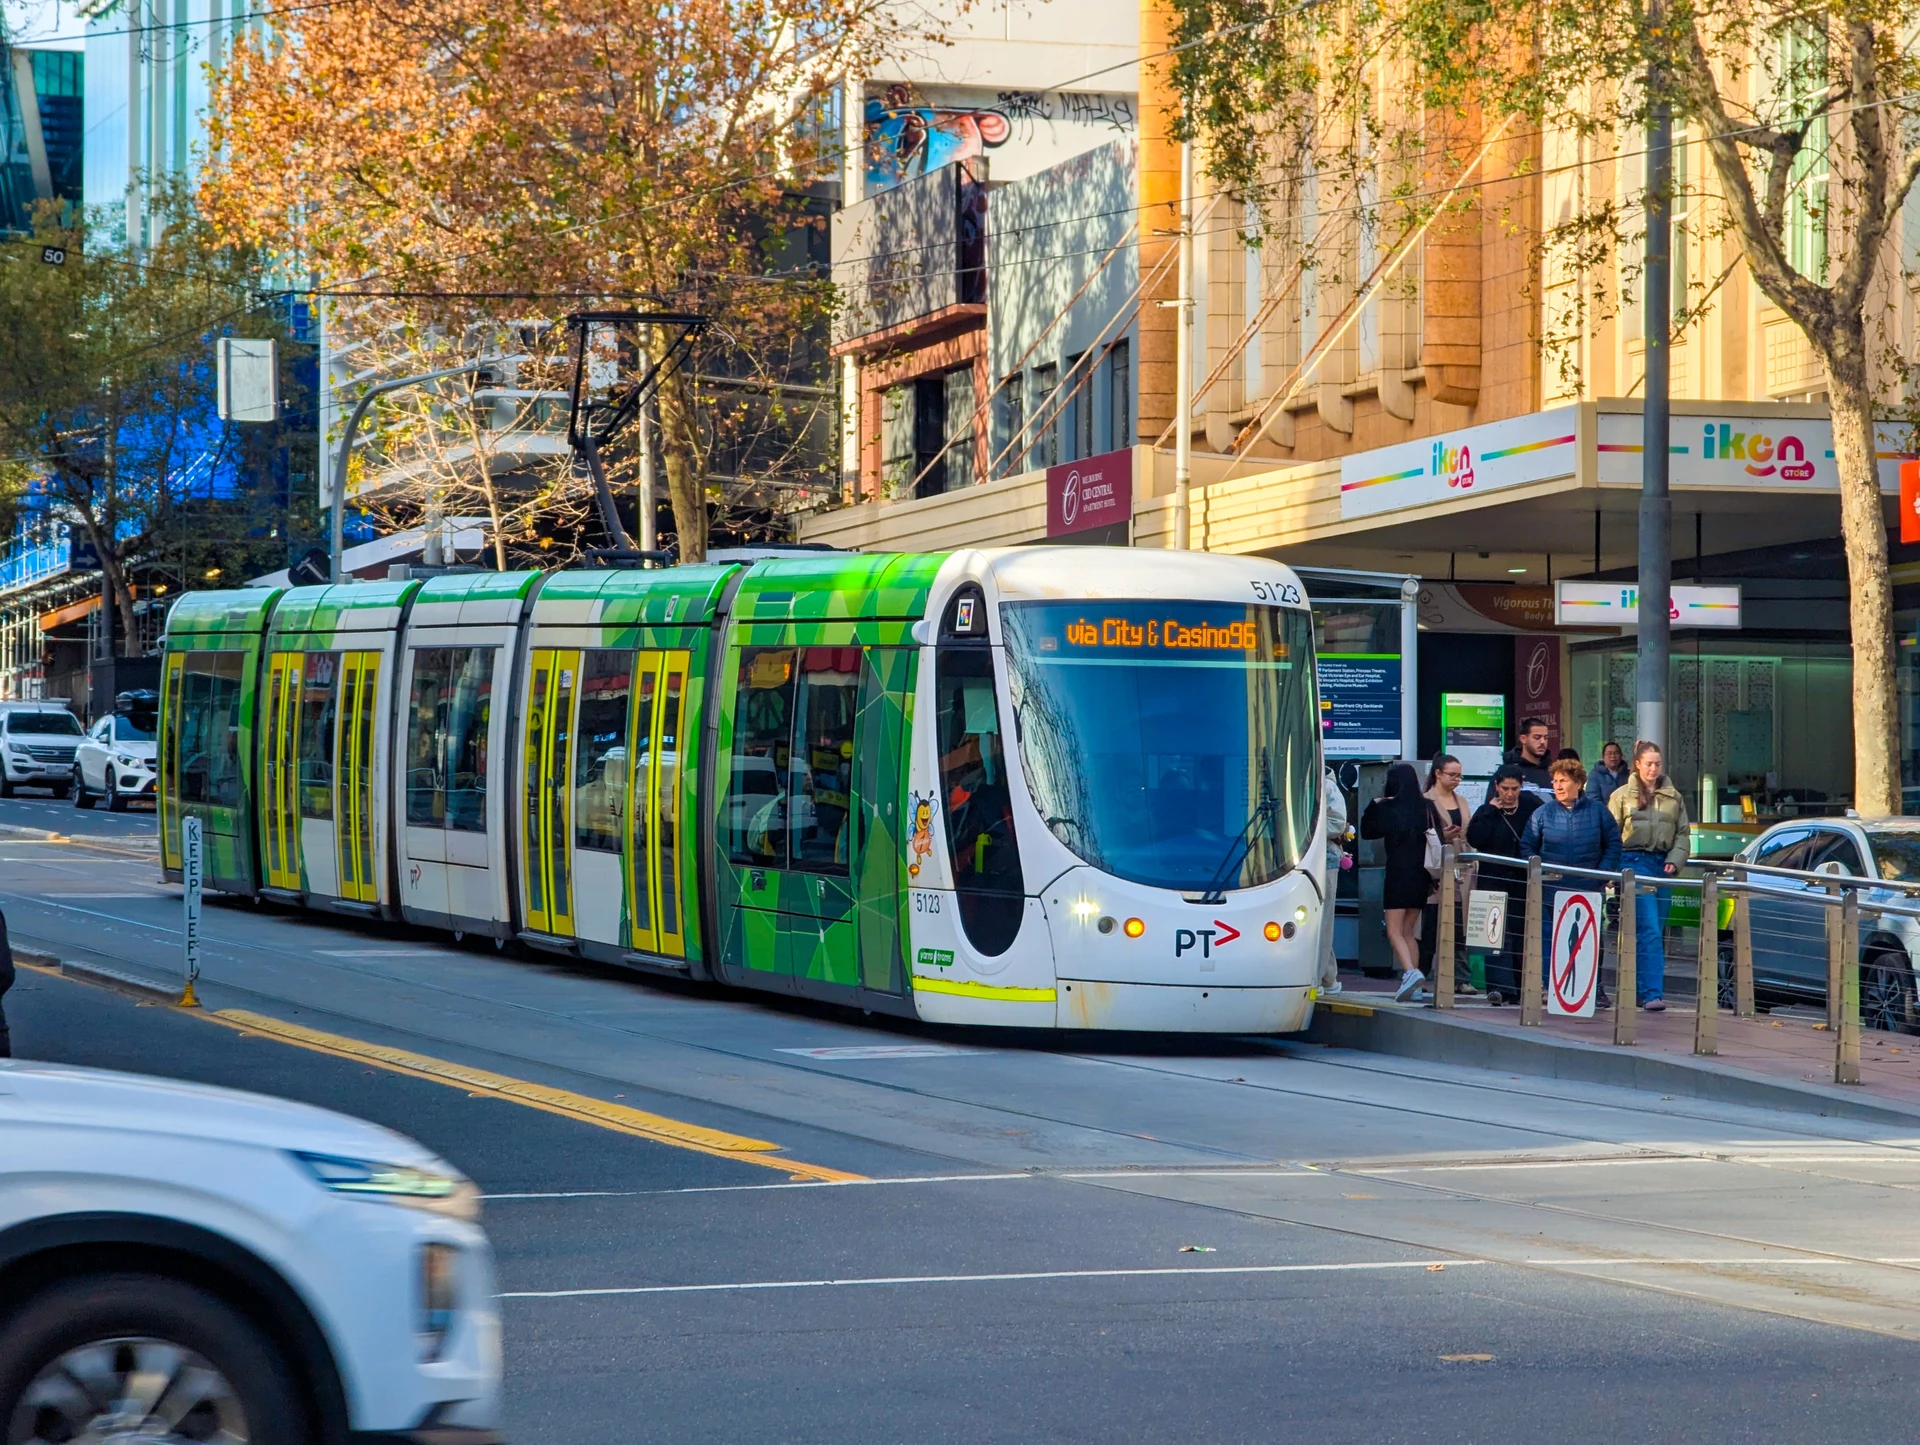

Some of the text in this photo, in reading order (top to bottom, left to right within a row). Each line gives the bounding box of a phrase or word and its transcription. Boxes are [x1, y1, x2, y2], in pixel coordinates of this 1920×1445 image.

[44, 248, 64, 265] 50
[1703, 423, 1805, 462] ikon
[1432, 440, 1470, 476] ikon
[1082, 472, 1103, 484] MELBOURNE
[1784, 469, 1809, 477] STORE
[1082, 483, 1113, 501] CBD CENTRAL
[1249, 580, 1302, 605] 5123
[1493, 596, 1540, 609] Vigorous
[1524, 612, 1545, 622] Body
[1067, 618, 1098, 644] via
[1101, 617, 1144, 647] City
[1147, 620, 1158, 646] &
[187, 824, 199, 973] KEEP LEFT
[916, 893, 941, 914] 5123
[1671, 895, 1685, 907] FREE
[1175, 929, 1216, 958] PT
[920, 952, 952, 963] yarra trams
